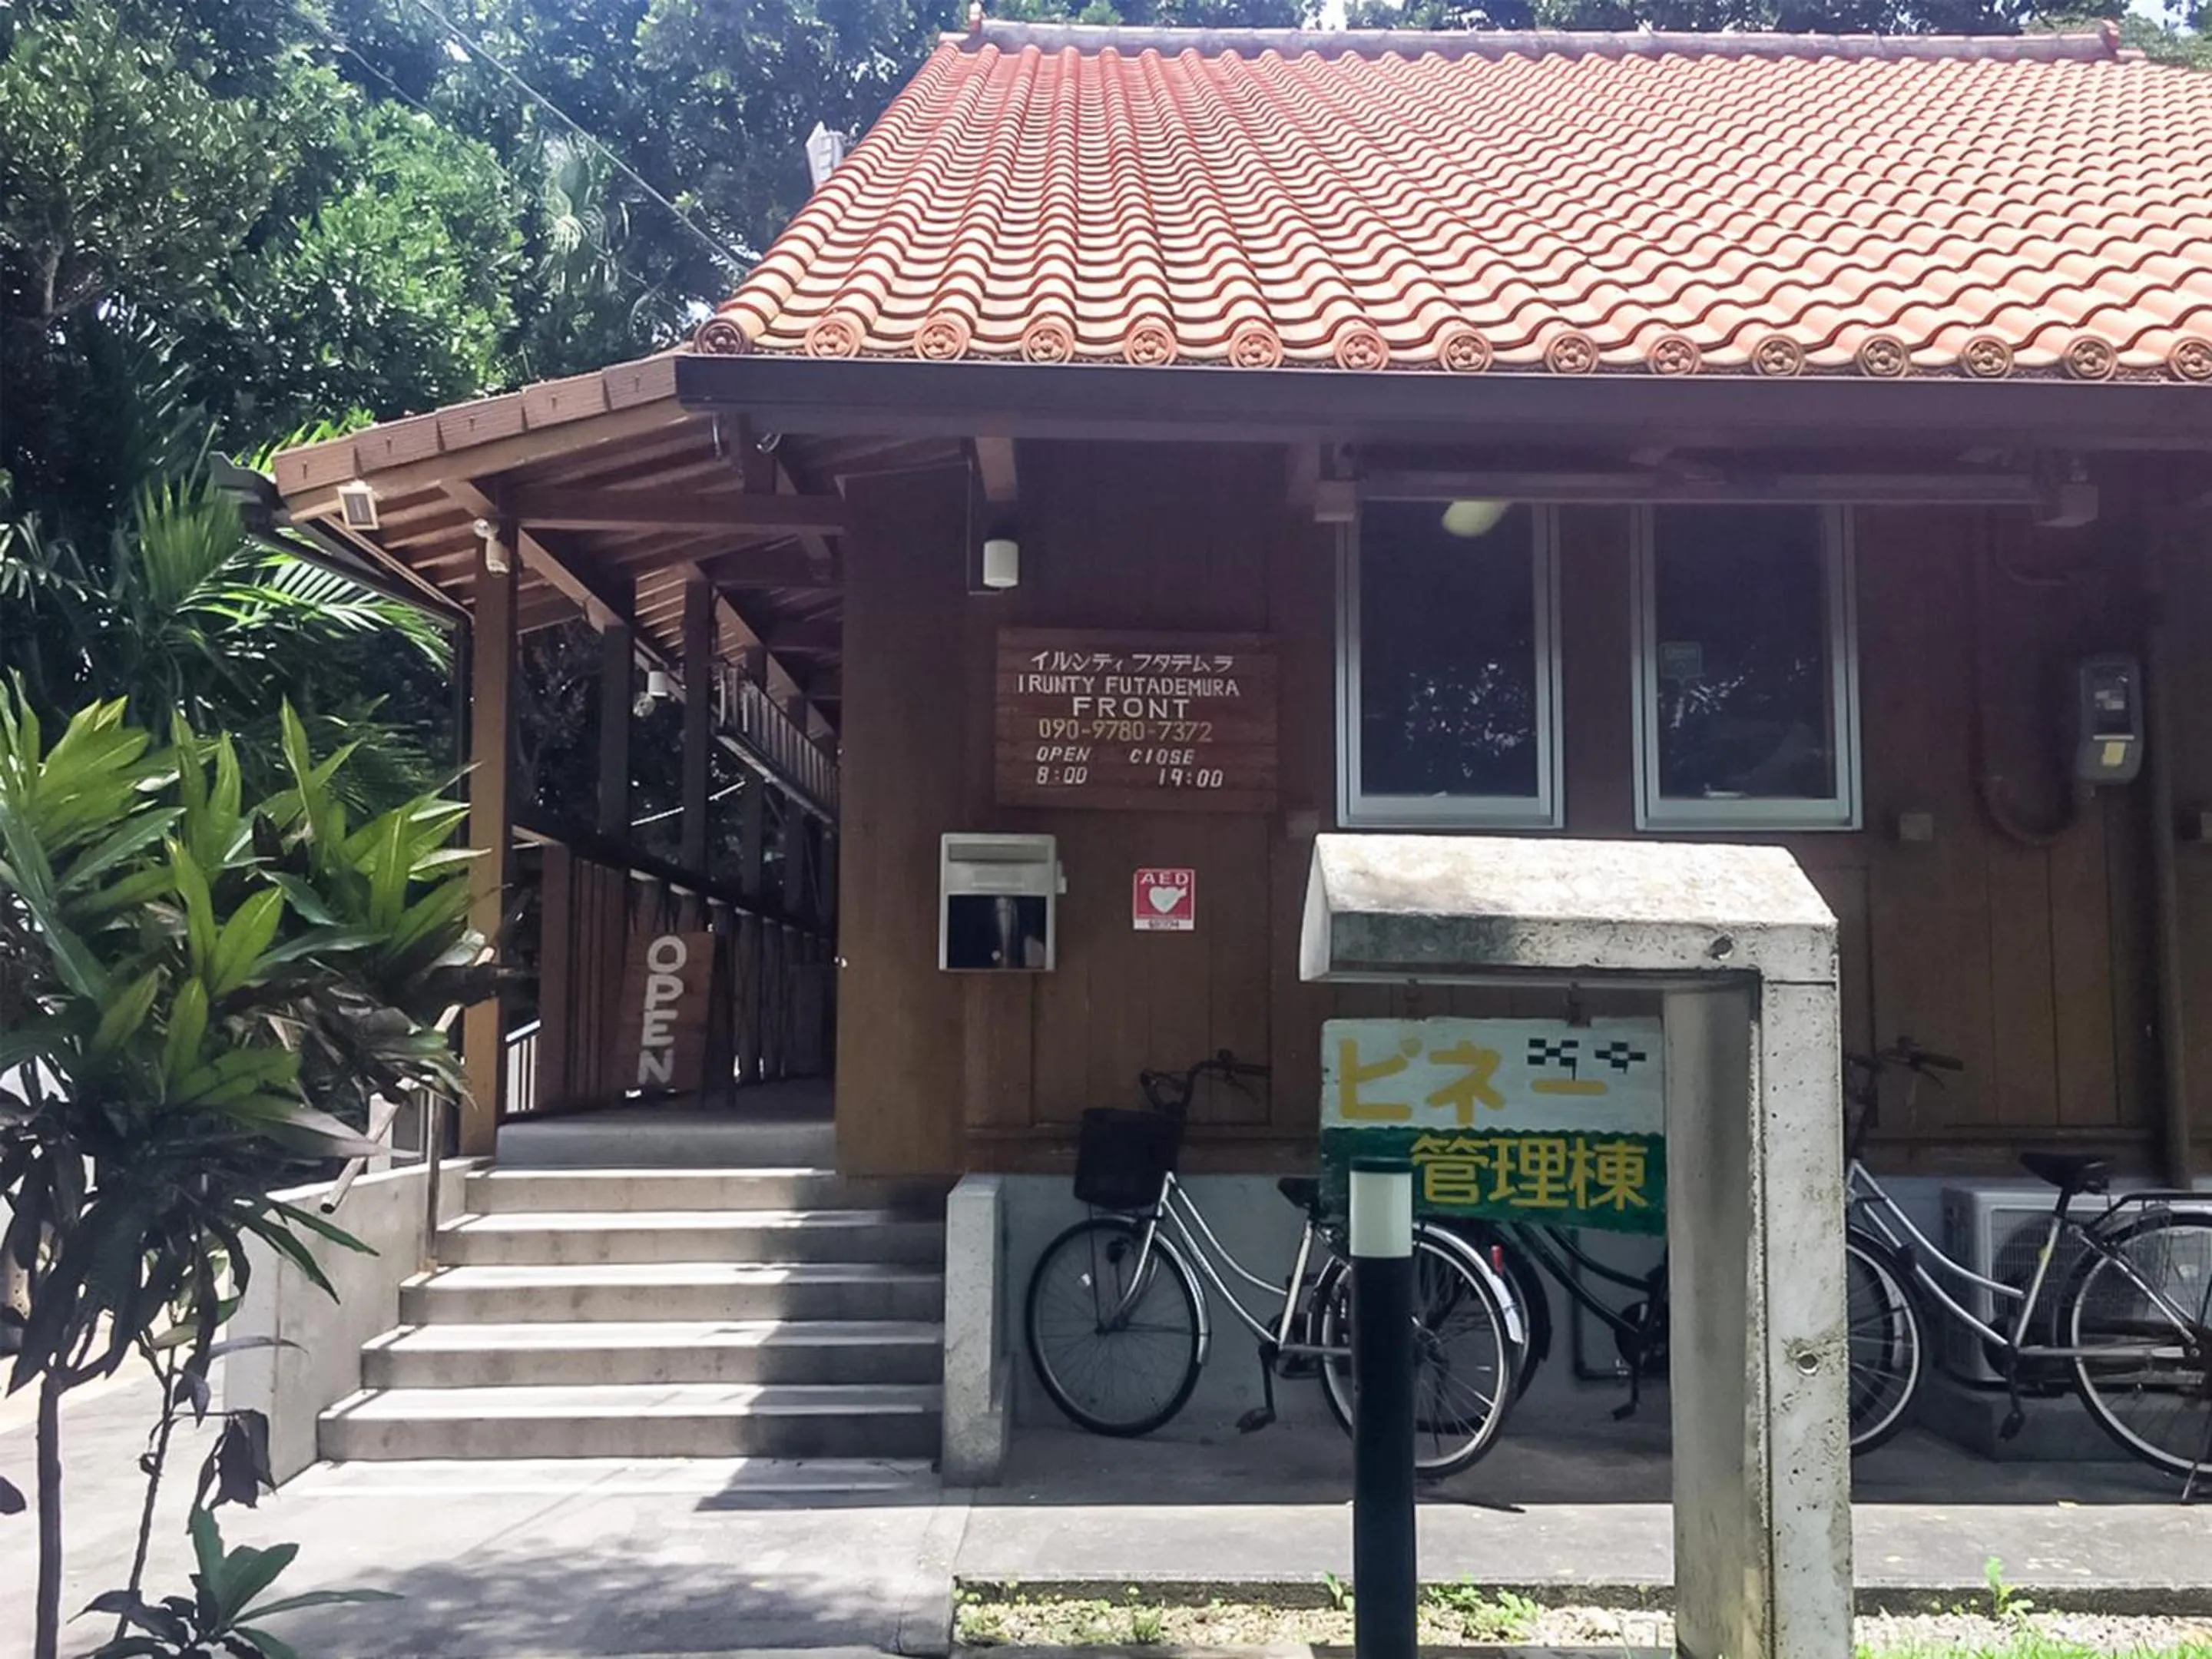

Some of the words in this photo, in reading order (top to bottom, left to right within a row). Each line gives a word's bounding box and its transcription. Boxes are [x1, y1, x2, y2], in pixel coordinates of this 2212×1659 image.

[1031, 651, 1122, 672] イルンティ
[1018, 674, 1096, 694] IRUNTY
[1105, 676, 1240, 697] FUTADEMURA
[1072, 696, 1190, 719] FRONT
[1038, 718, 1213, 742] 090-9780-7372
[1036, 746, 1091, 762] OPEN
[1036, 767, 1088, 784] 8:00
[1159, 769, 1224, 788] 19:00
[1140, 873, 1190, 885] AED
[637, 935, 687, 1084] OPEN
[1411, 1134, 1648, 1211] 管理棟
